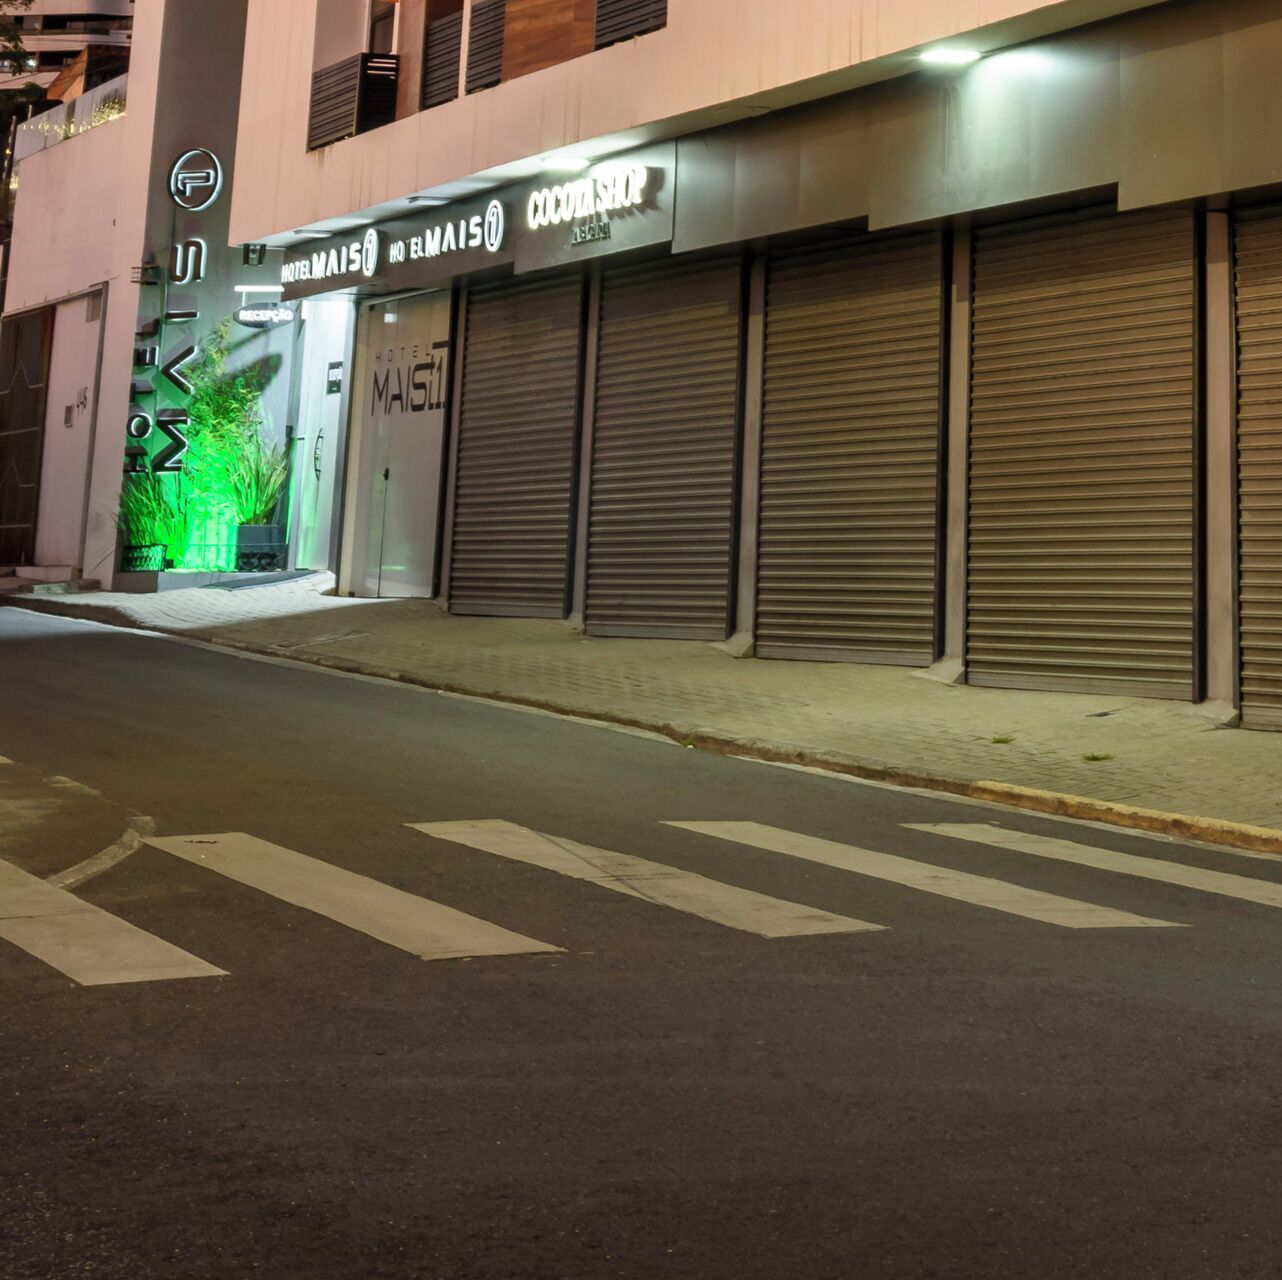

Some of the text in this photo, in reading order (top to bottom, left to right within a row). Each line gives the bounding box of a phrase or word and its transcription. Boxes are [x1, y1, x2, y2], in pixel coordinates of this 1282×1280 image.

[596, 164, 648, 213] SHOP
[281, 259, 313, 284] HOTEL
[375, 344, 431, 363] HOTEL
